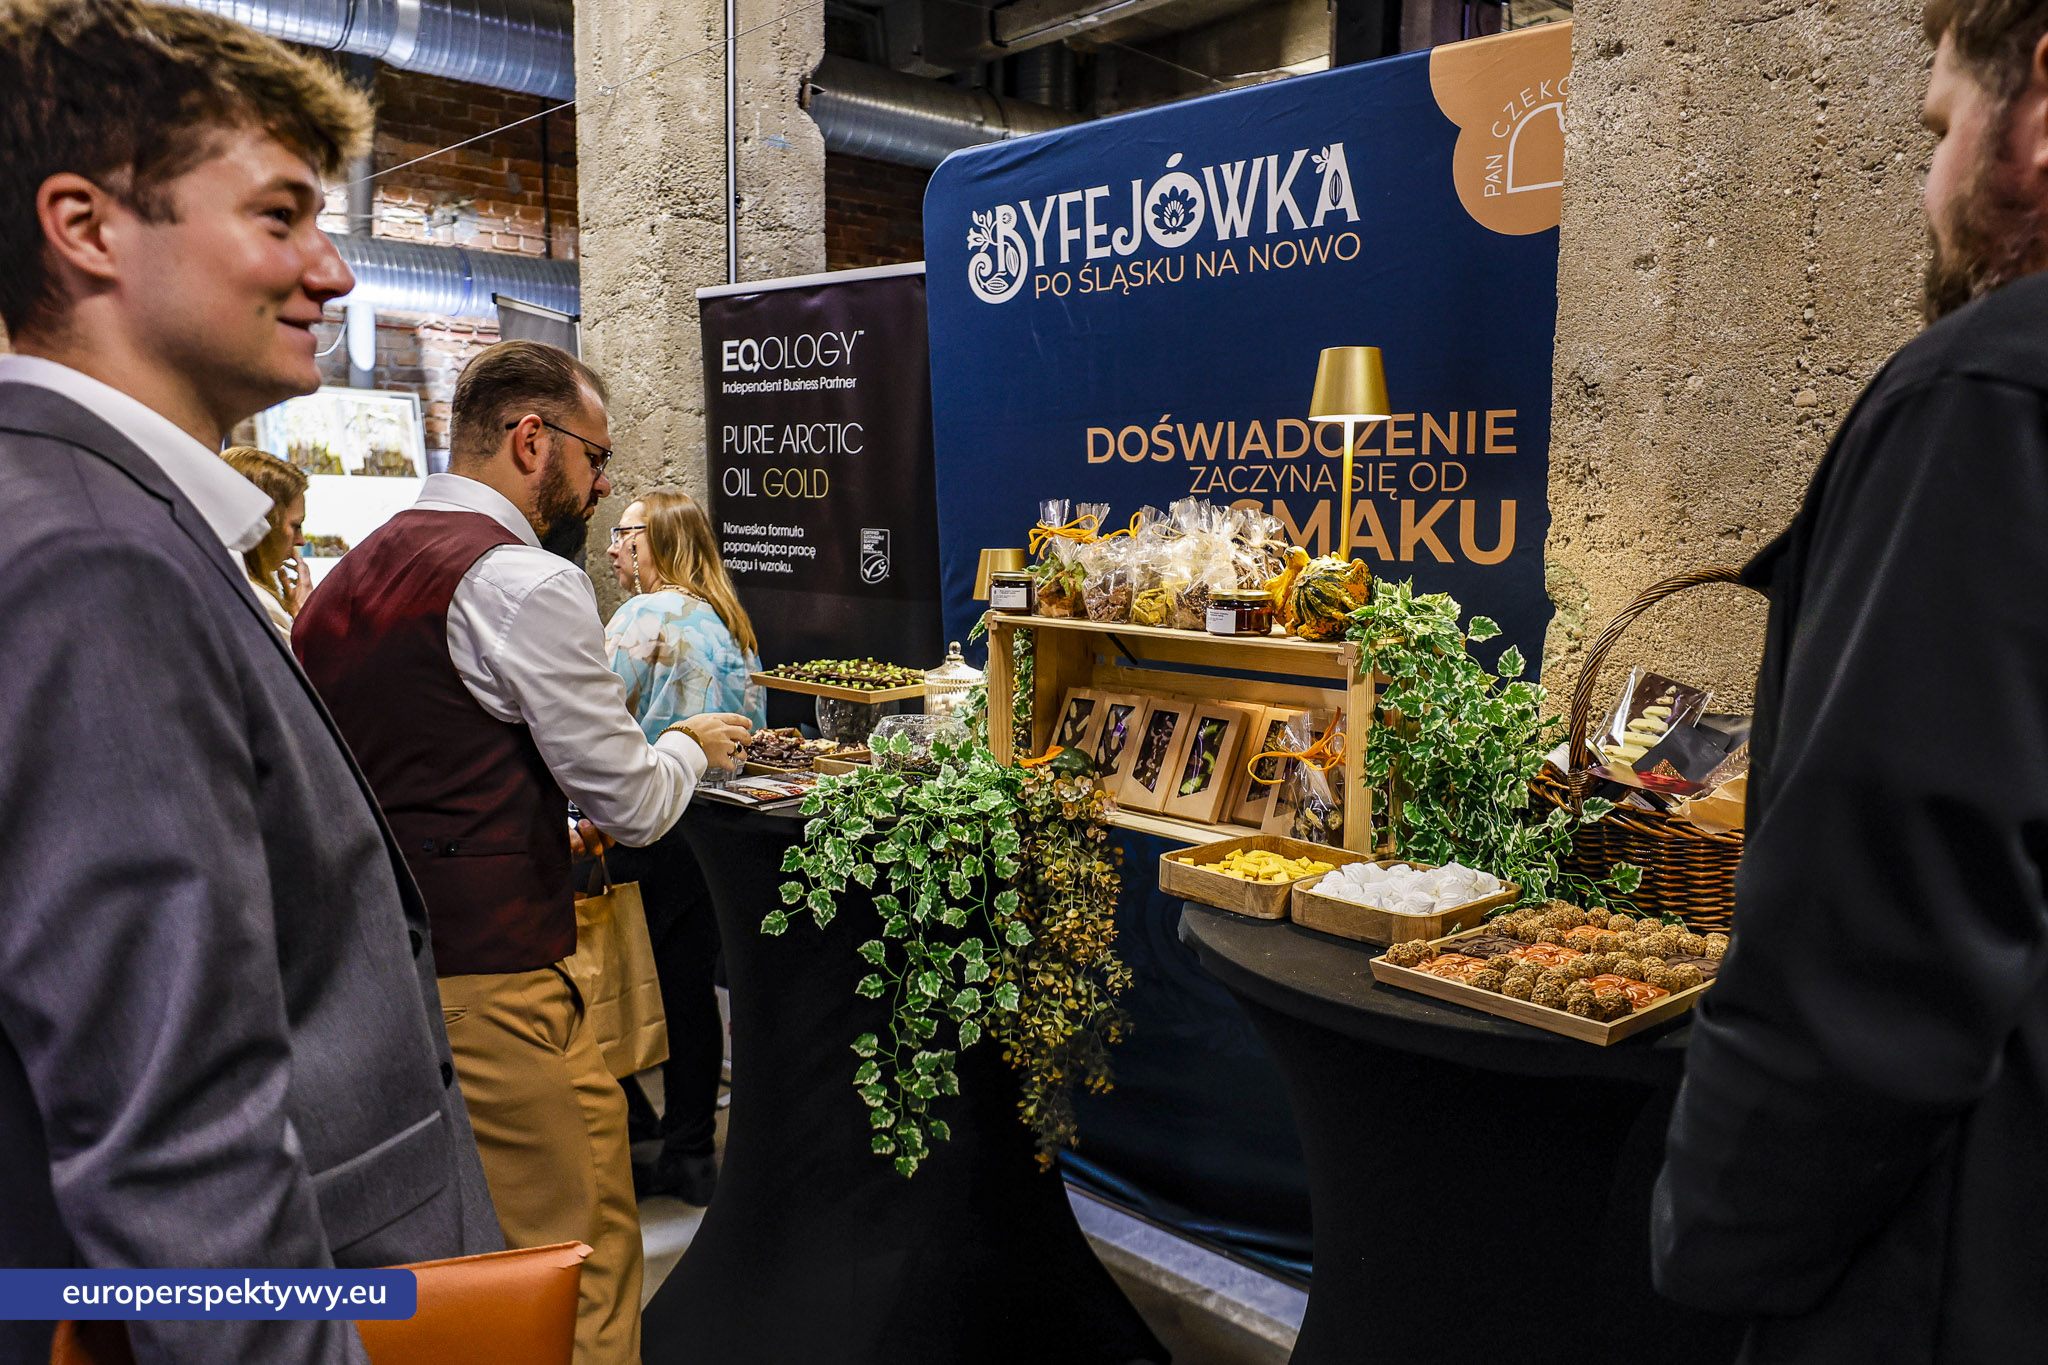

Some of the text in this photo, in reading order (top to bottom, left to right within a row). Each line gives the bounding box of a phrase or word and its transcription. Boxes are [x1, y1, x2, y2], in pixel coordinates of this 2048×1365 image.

[1484, 154, 1503, 197] PAN
[967, 142, 1360, 304] BYFEJÓWKA
[1034, 231, 1362, 299] PO ŚLĄSKU NA NOWO
[722, 375, 857, 395] Independent Business Partner
[723, 422, 864, 454] PURE ARCTIC
[1086, 409, 1517, 464] DOŚWIADCZENIE
[723, 467, 829, 498] OIL GOLD
[1189, 461, 1467, 500] ZACZYNA SIĘ OD
[723, 521, 767, 536] Norweska
[1230, 498, 1517, 566] MAKU
[723, 541, 817, 560] poprawiająca pracę
[723, 557, 753, 573] mózgu
[759, 559, 794, 573] wzroku.
